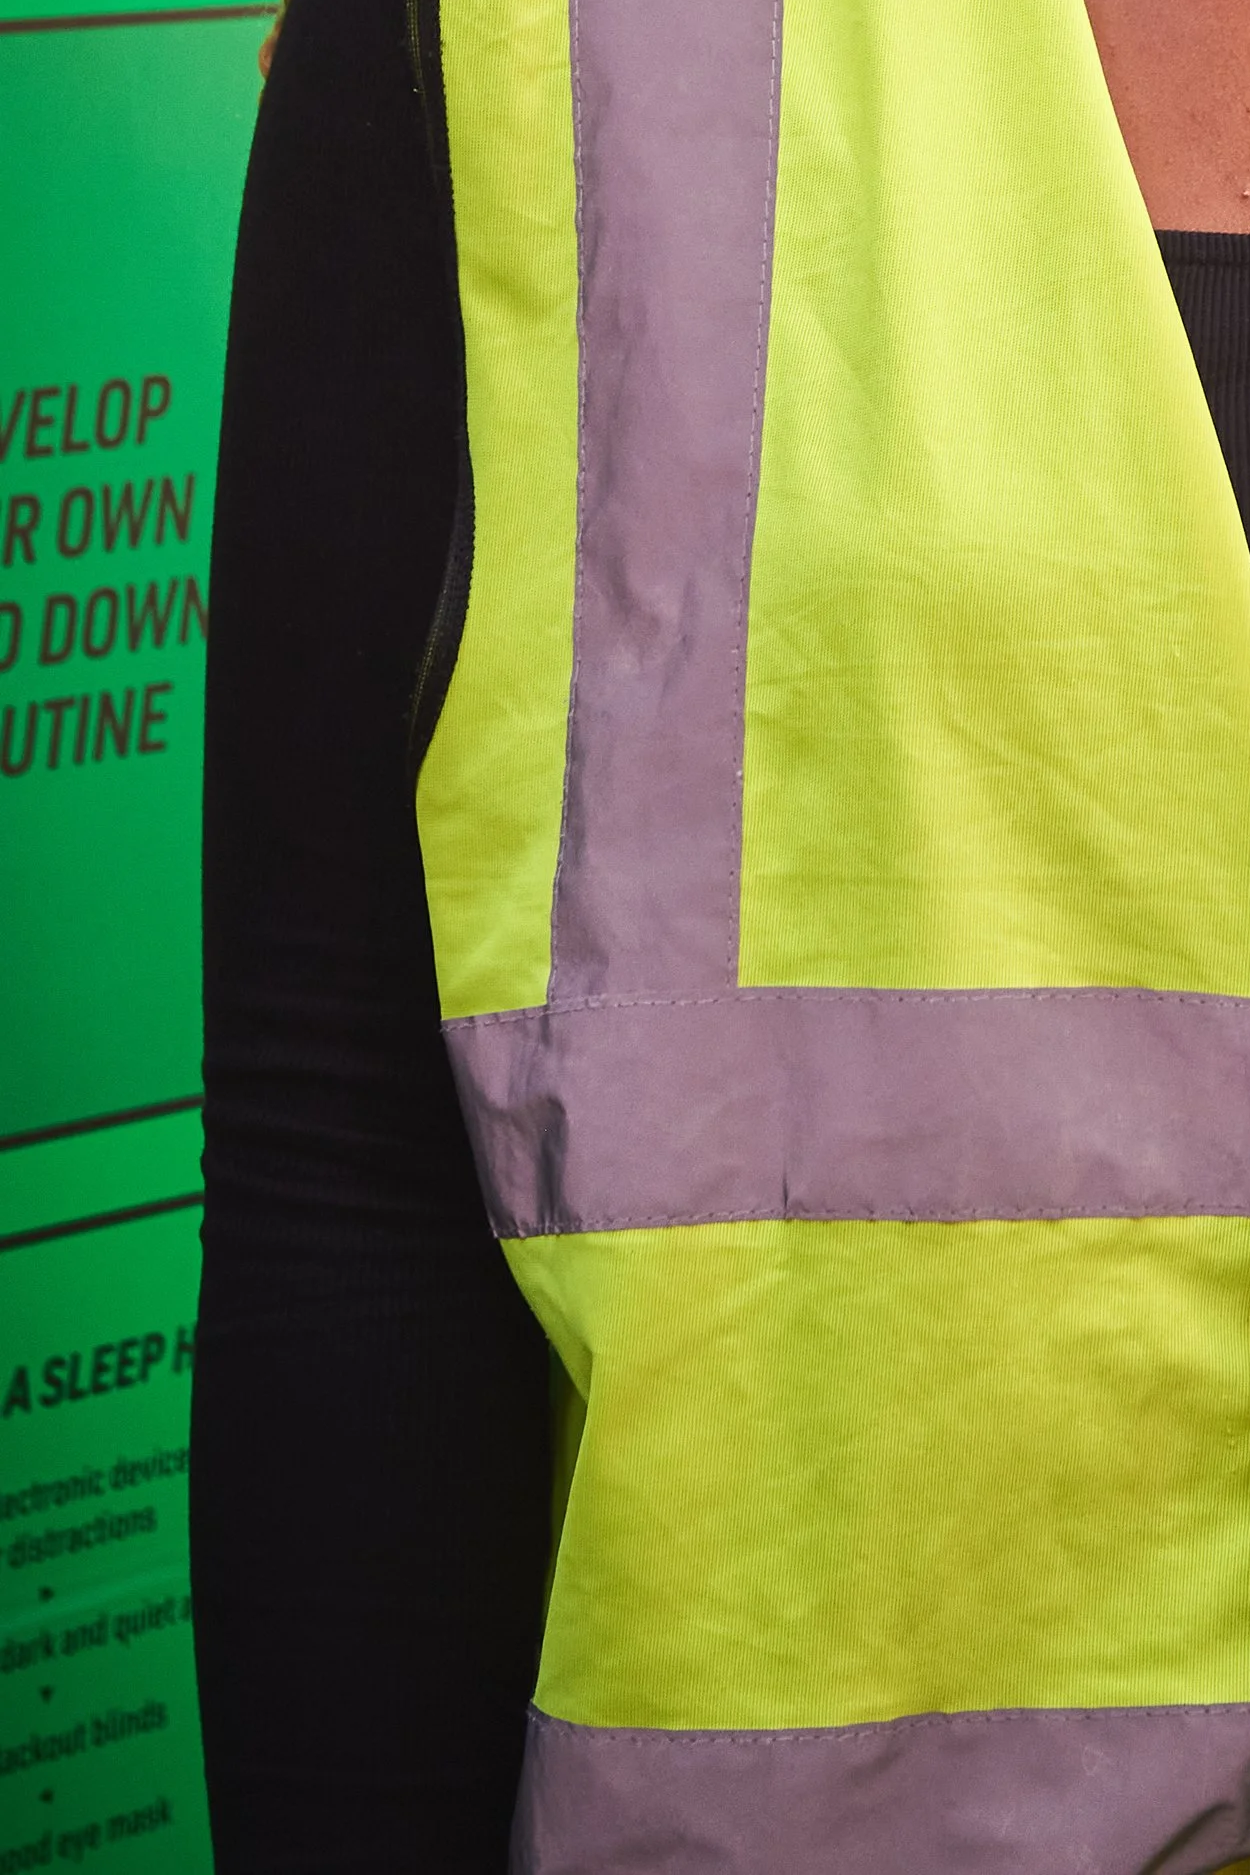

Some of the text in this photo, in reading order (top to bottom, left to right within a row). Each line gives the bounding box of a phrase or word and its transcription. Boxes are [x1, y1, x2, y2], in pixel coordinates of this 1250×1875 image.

[56, 471, 196, 560] OWN
[39, 574, 208, 668] DOWN
[2, 1364, 33, 1420] A
[38, 1331, 168, 1410] SLEEP
[0, 1464, 105, 1520] ectronic
[8, 1506, 157, 1568] distractions
[60, 1614, 108, 1657] and
[114, 1598, 176, 1648] quiet
[92, 1700, 169, 1747] blinds
